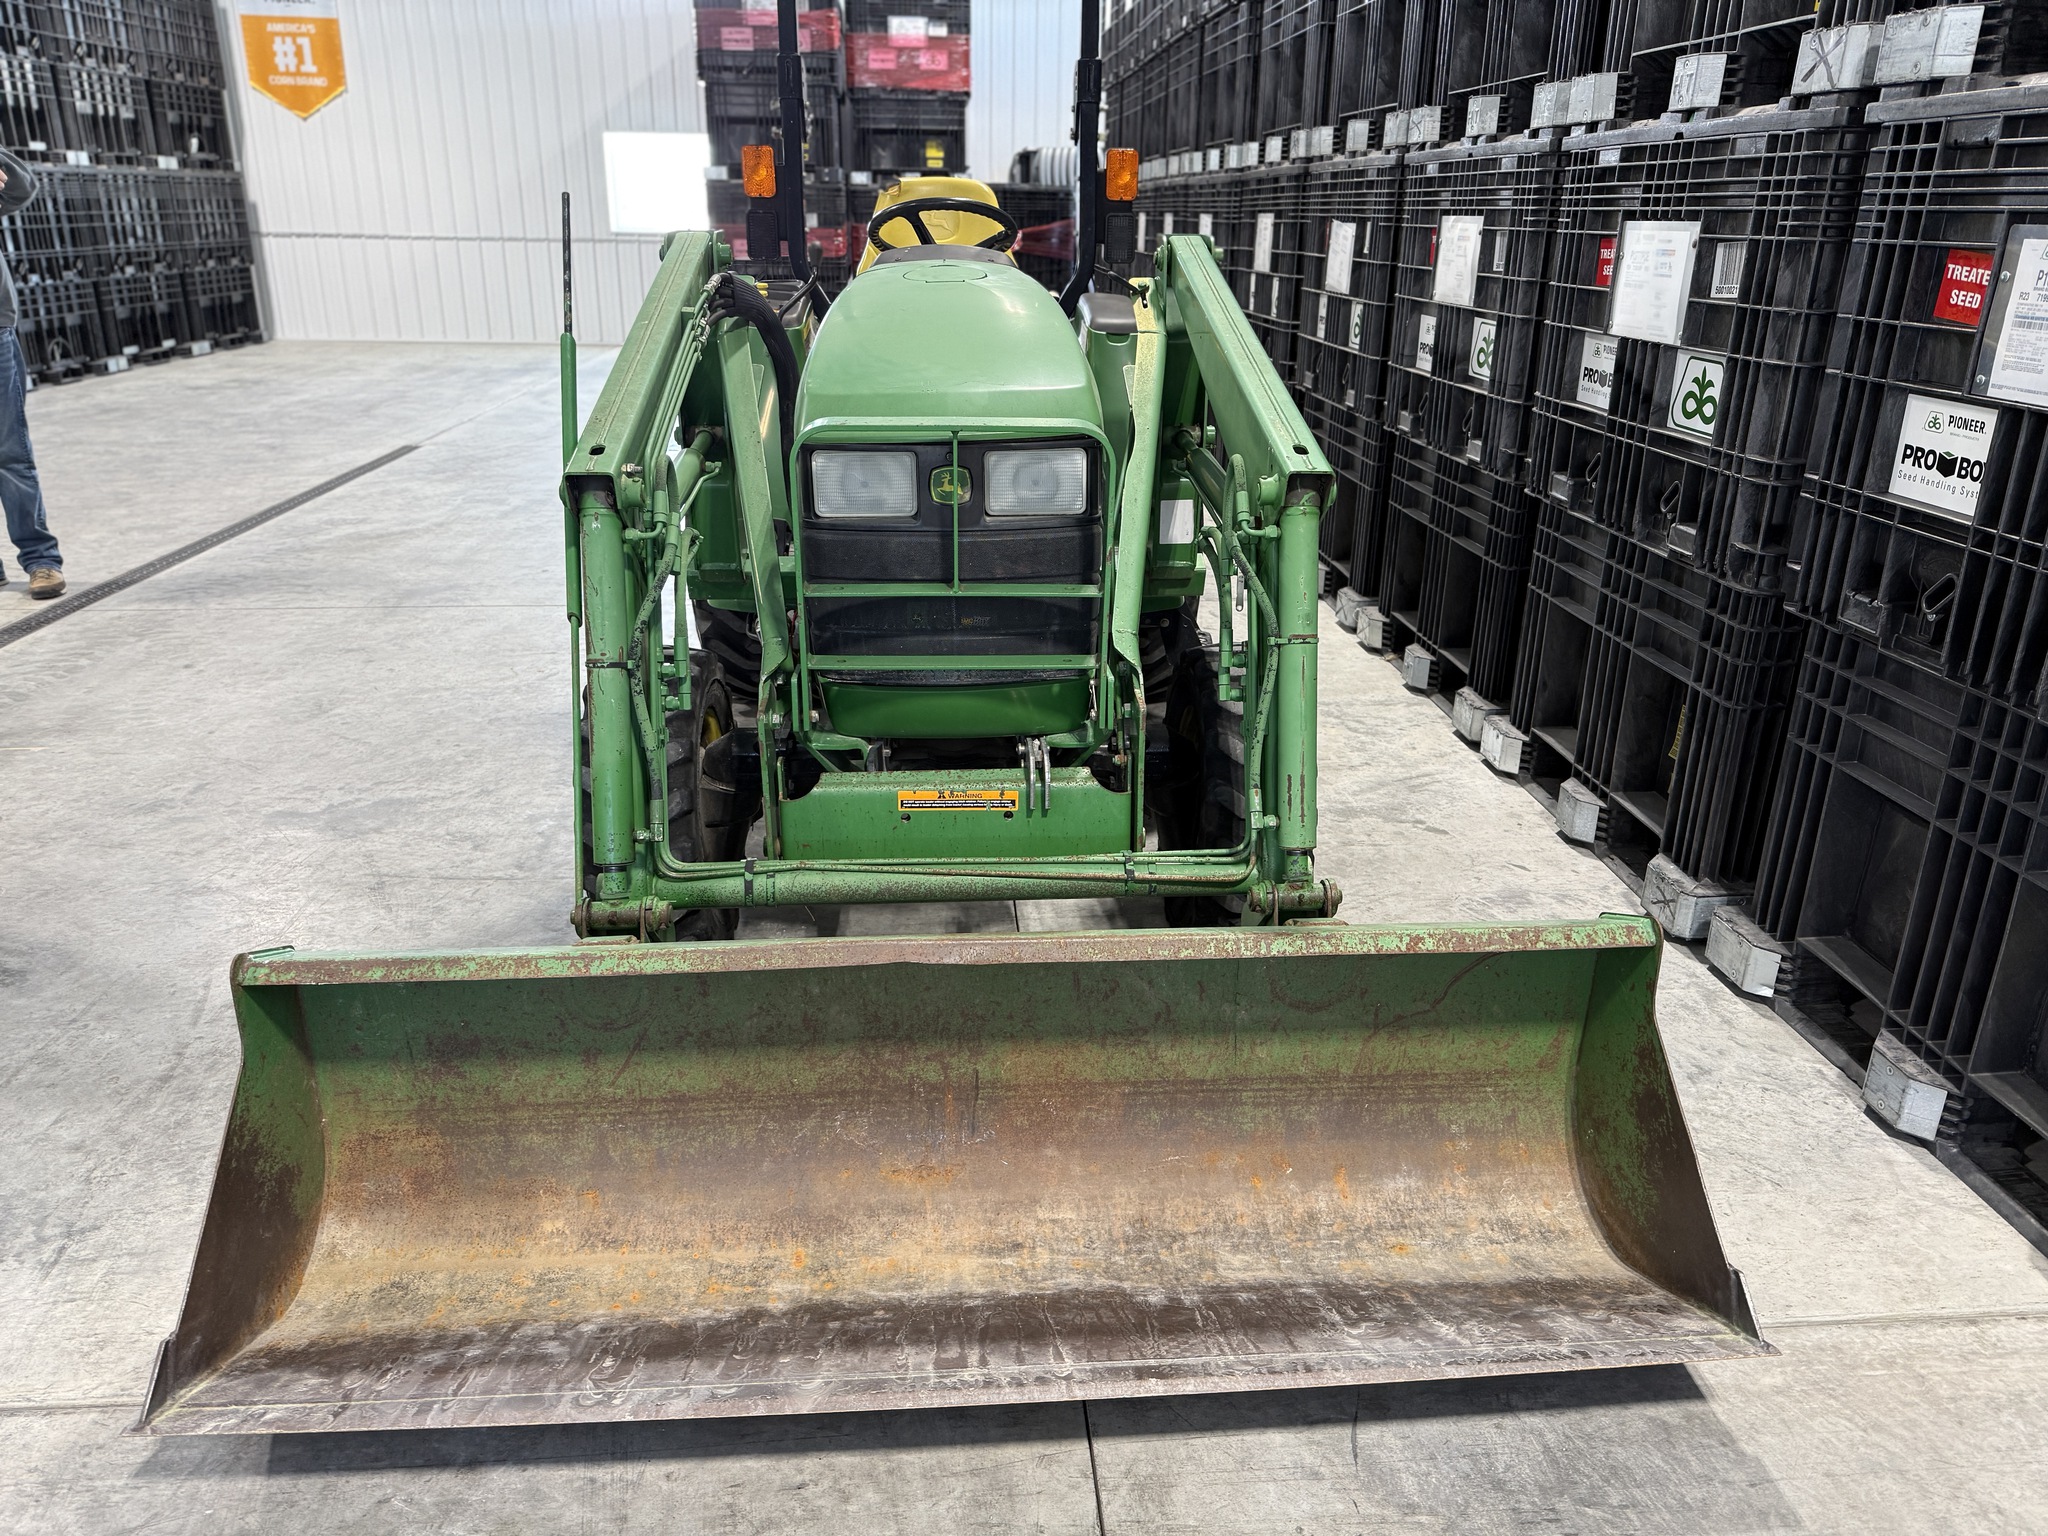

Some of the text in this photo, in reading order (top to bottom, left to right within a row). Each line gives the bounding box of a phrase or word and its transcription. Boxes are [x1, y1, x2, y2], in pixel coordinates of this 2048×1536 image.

[266, 22, 316, 34] AMERICA'S
[272, 36, 318, 73] #1
[268, 74, 329, 87] CORN BRAND
[1600, 248, 1616, 260] TREA
[1602, 264, 1614, 276] SEE
[1947, 263, 1992, 286] TREATE
[1949, 289, 1982, 309] SEED
[1582, 366, 1600, 385] PRO
[1948, 414, 1986, 435] PIONEER
[1956, 456, 1987, 484] BO
[1897, 469, 1980, 499] Seed Handling Syst
